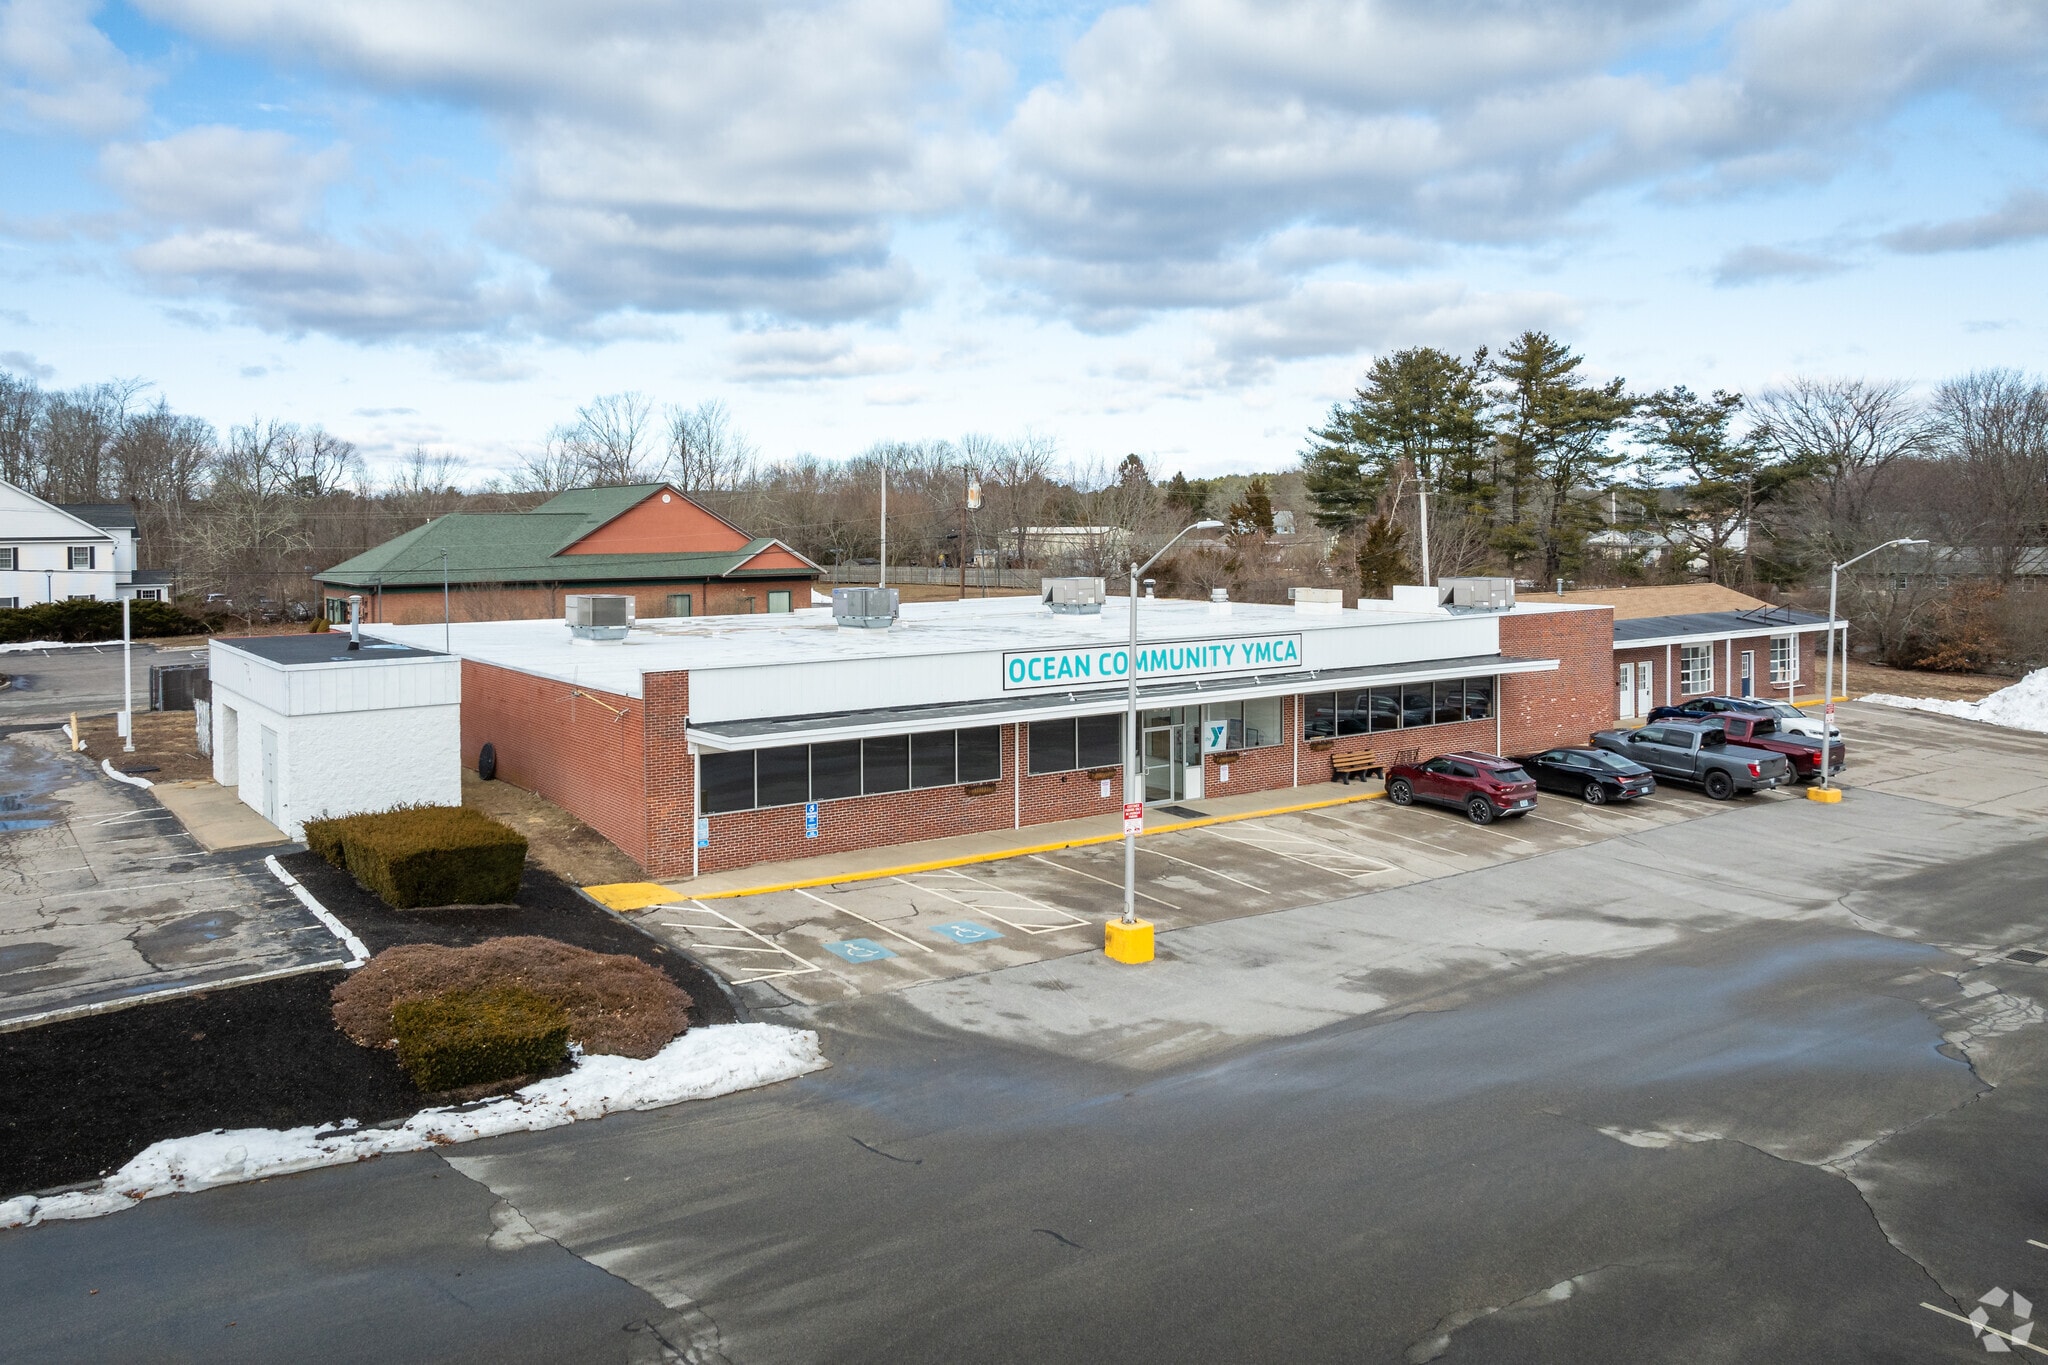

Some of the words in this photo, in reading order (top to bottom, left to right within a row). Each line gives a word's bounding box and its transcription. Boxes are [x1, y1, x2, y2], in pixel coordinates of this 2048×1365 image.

[1008, 654, 1091, 683] OCEAN
[1099, 644, 1235, 675] COMMUNITY
[1241, 640, 1298, 664] YMCA
